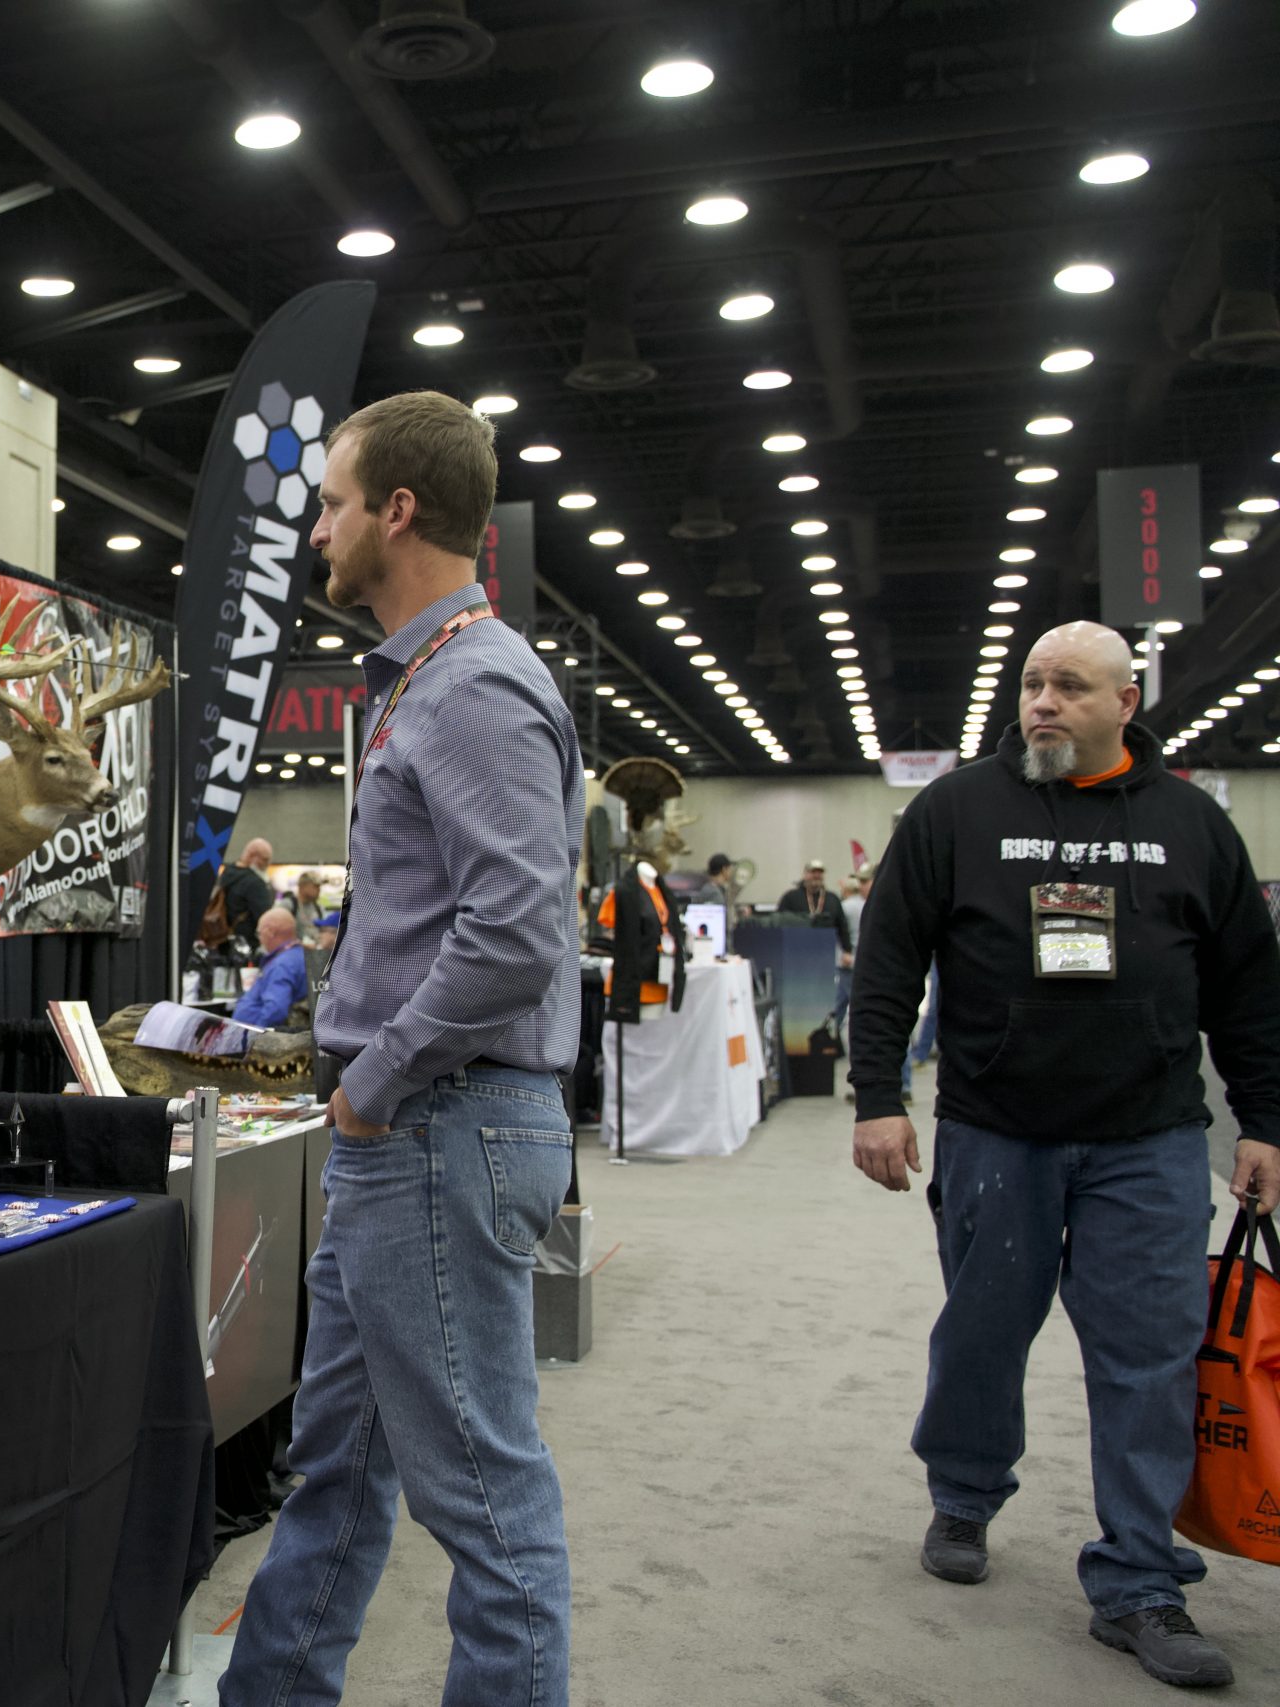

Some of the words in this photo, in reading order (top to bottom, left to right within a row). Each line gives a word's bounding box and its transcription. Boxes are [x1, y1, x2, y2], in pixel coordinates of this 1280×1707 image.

[210, 513, 257, 679] TARGET
[1140, 487, 1161, 605] 3000
[188, 515, 300, 877] MATRIX
